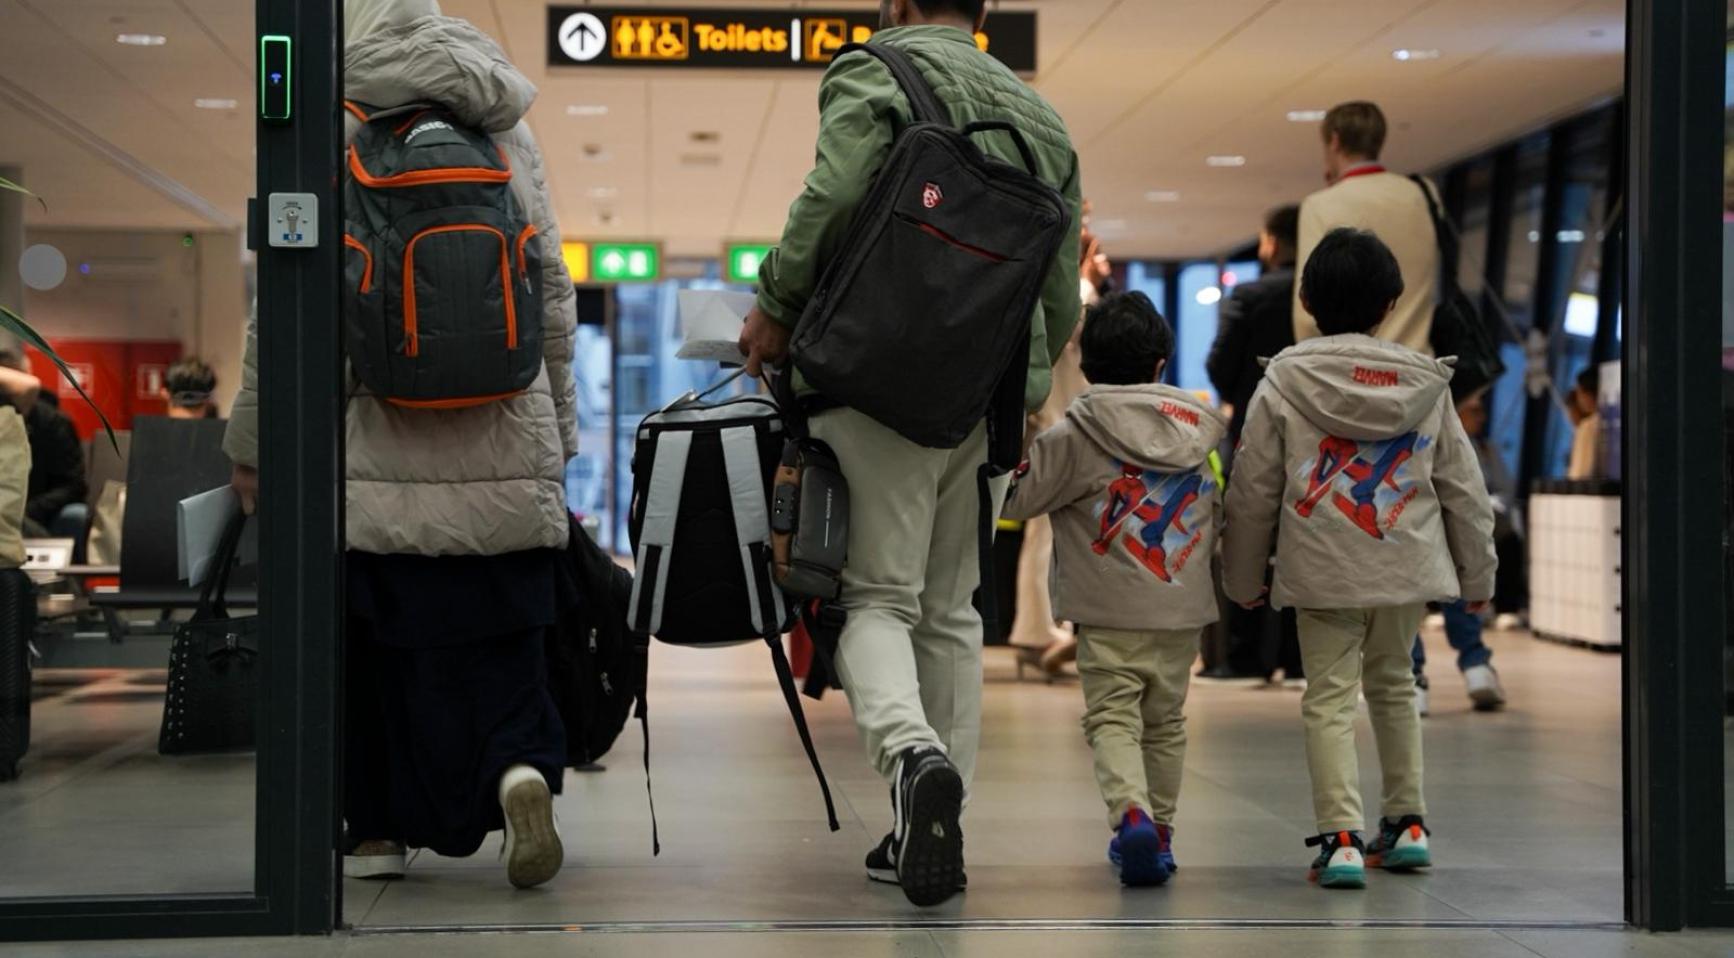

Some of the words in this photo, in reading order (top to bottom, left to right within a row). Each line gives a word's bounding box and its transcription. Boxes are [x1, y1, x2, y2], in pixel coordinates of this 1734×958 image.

[693, 22, 788, 52] Toilets
[1353, 364, 1399, 387] MARVEL
[1158, 399, 1200, 427] MARVEL
